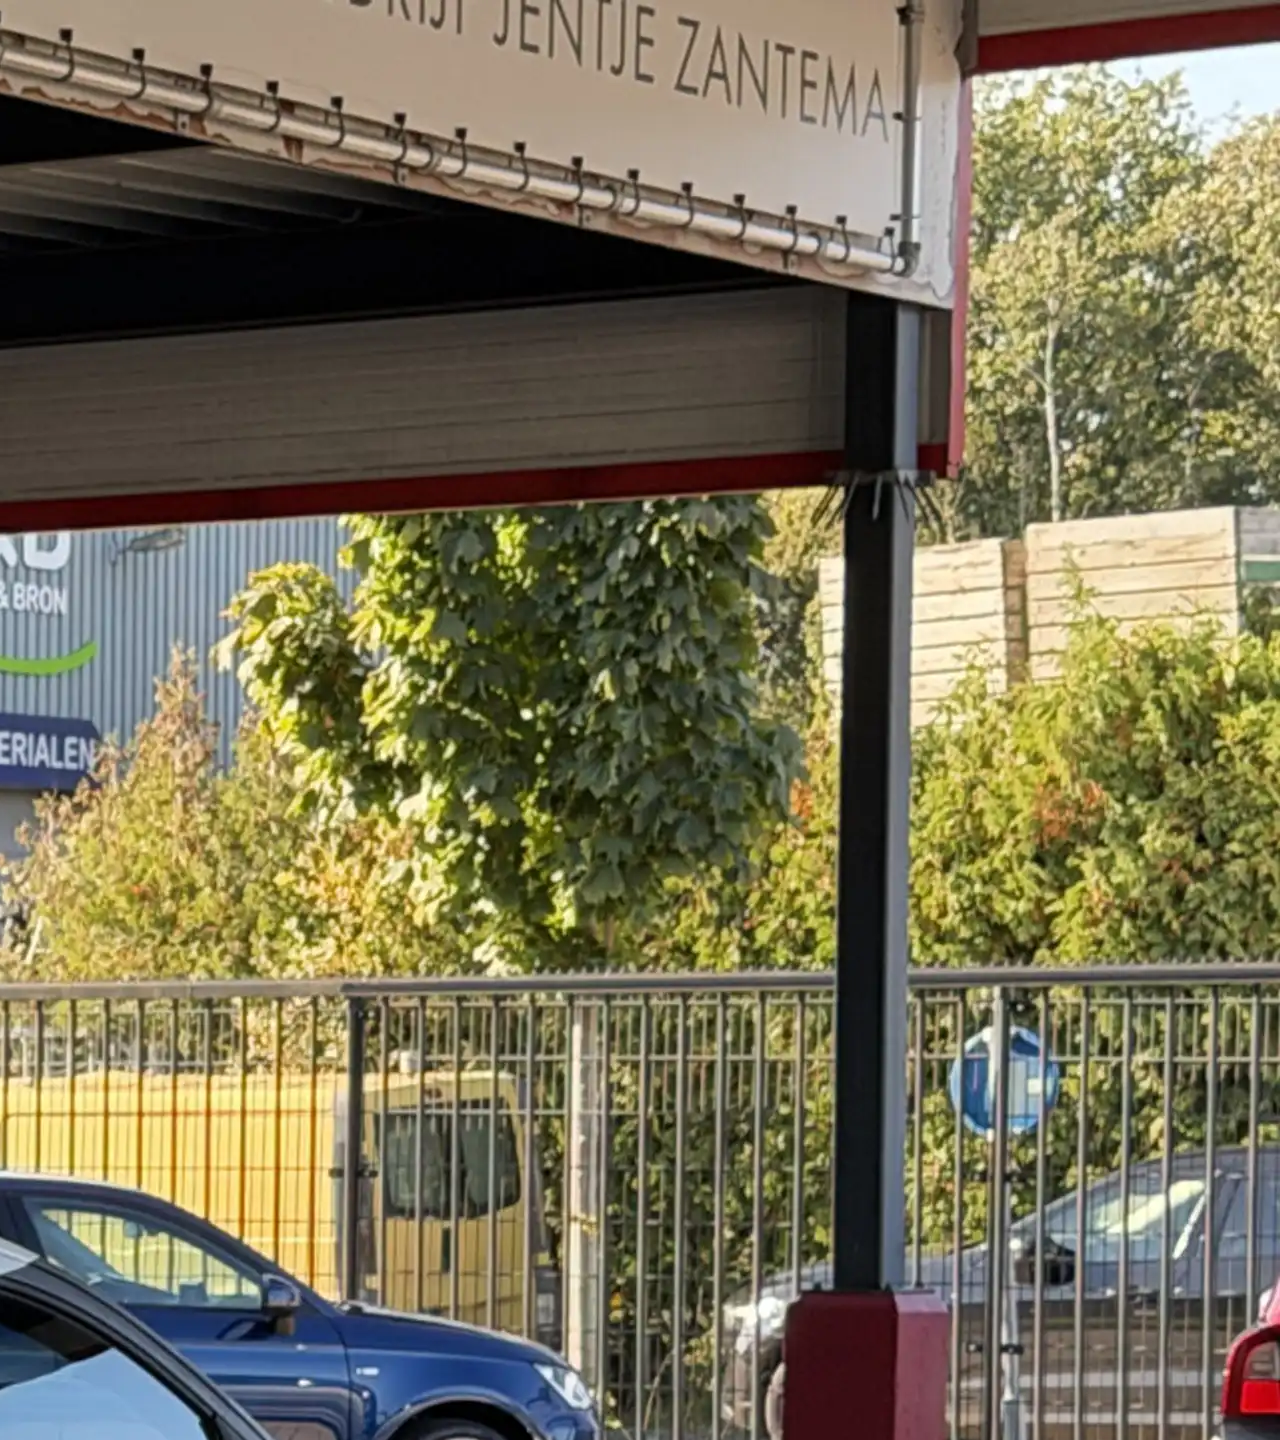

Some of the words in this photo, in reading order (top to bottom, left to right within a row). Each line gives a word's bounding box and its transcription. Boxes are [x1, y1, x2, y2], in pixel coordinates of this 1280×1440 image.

[493, 0, 655, 84] JENTJE
[674, 15, 889, 143] ZANTEMA
[13, 582, 68, 615] BRON
